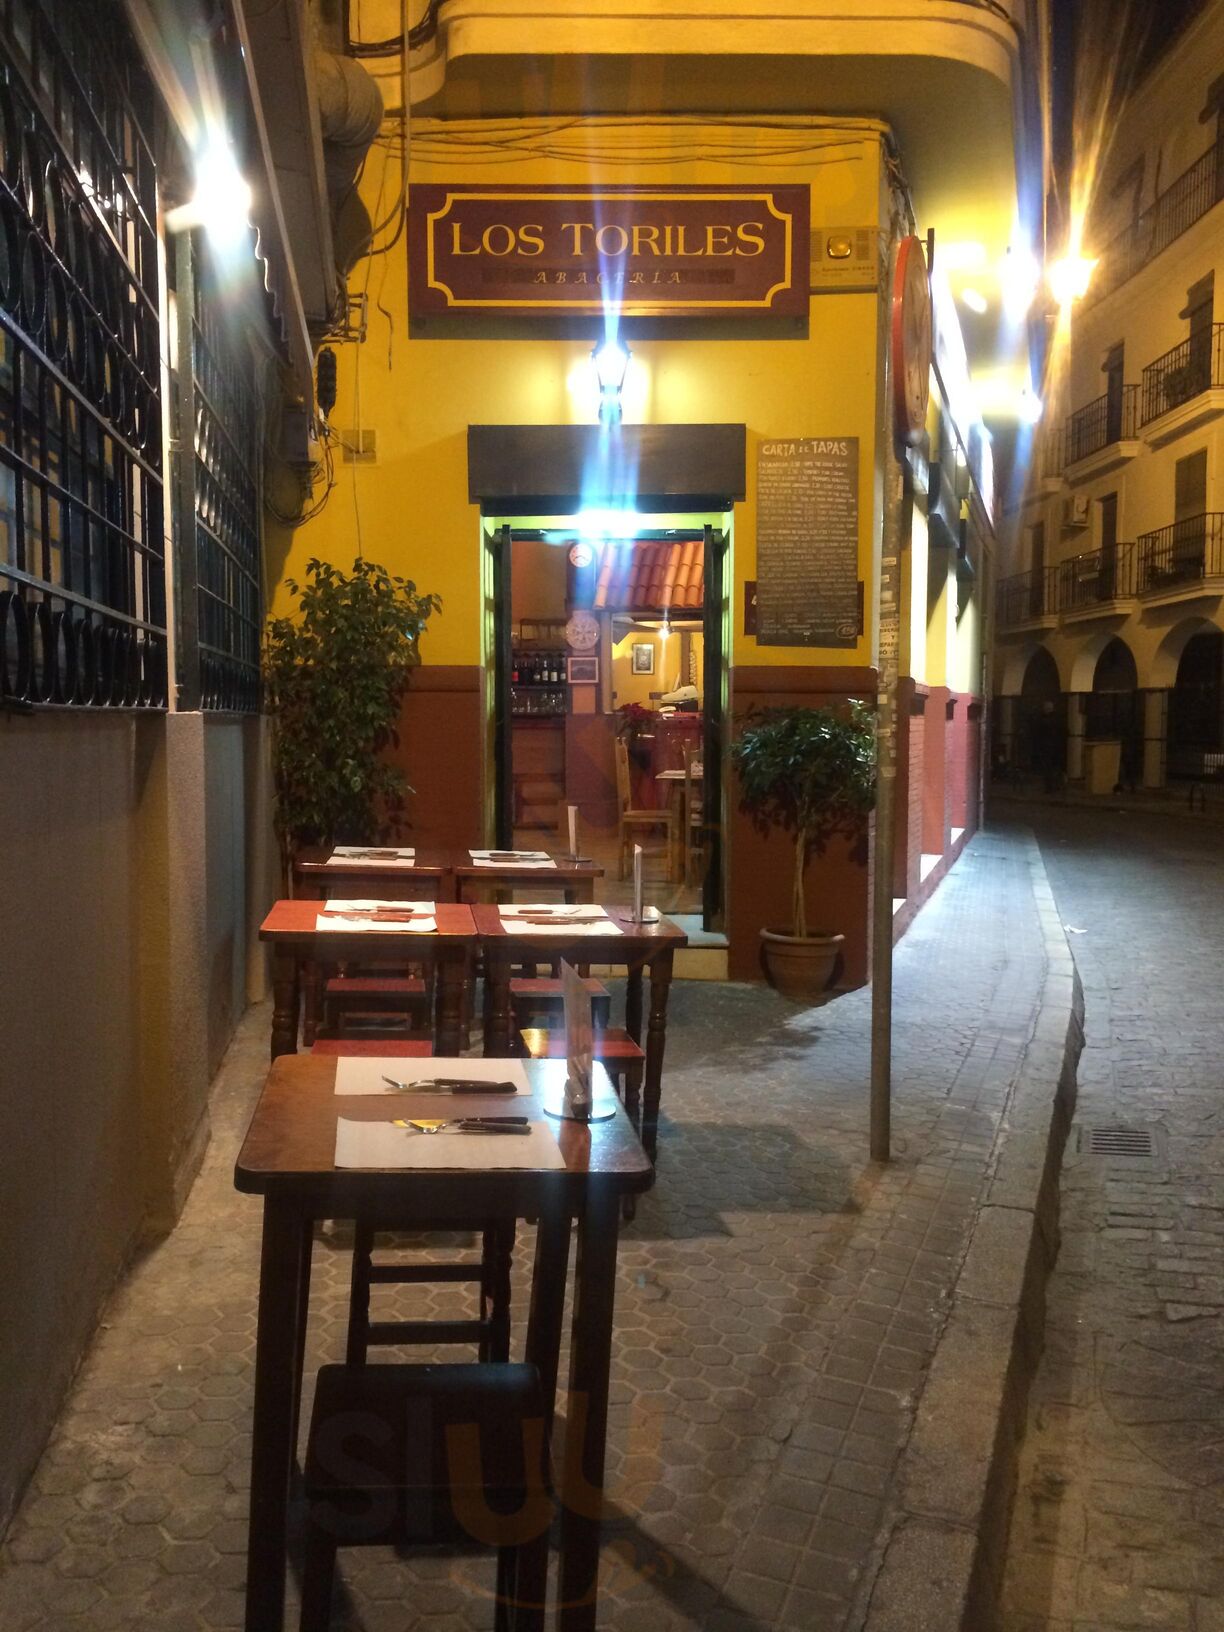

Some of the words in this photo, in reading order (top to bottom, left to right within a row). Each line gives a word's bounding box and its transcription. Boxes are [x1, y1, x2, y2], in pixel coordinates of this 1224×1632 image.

[450, 221, 545, 257] LOS
[560, 221, 766, 257] TORILES
[762, 443, 796, 457] CARTA
[811, 440, 848, 456] TAPAS
